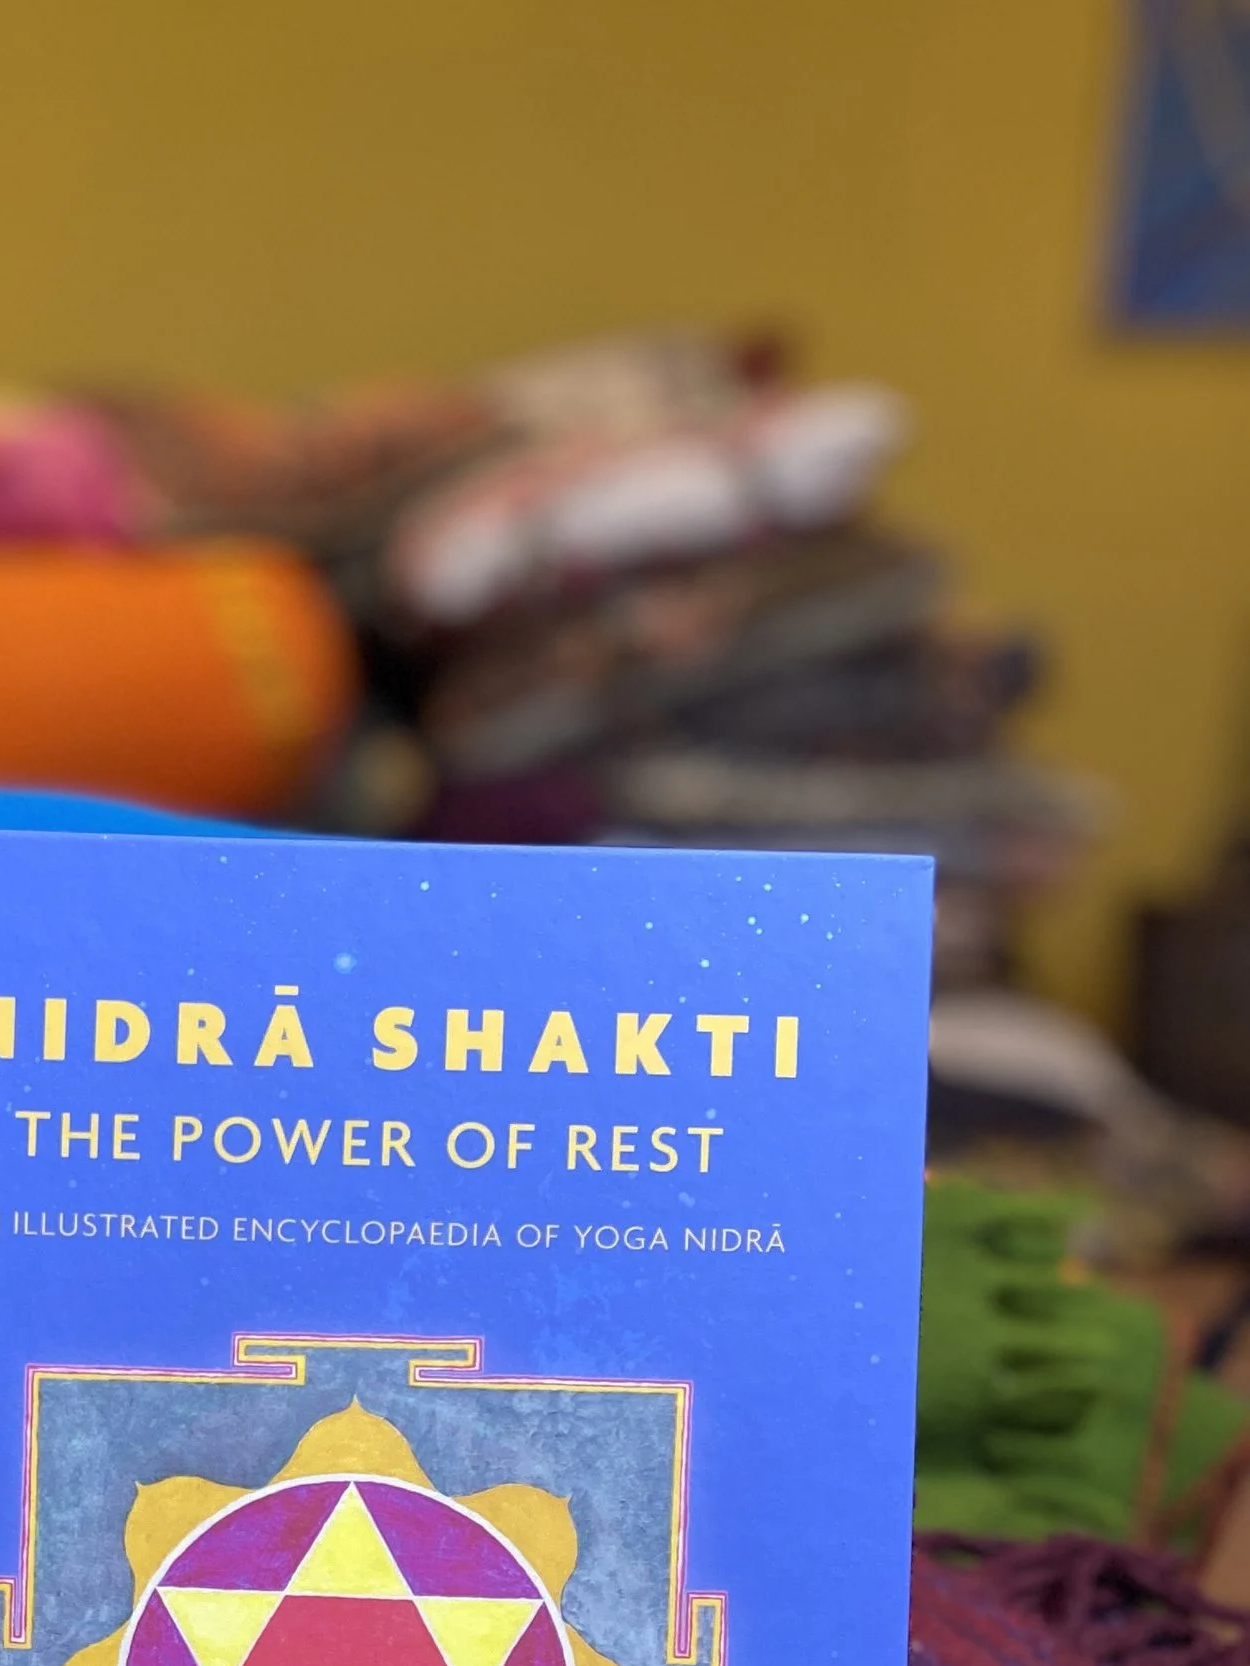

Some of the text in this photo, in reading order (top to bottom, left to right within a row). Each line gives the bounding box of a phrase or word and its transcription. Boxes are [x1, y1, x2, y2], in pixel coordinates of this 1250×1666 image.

[372, 1006, 799, 1079] SHAKTI
[14, 1110, 724, 1173] THE POWER OF REST
[14, 1211, 219, 1240] ILLUSTRATED
[233, 1217, 502, 1247] ENCYCLOPAEDIA
[516, 1223, 560, 1248] OF
[574, 1225, 669, 1250] YOGA
[684, 1223, 785, 1253] NIDRĀ
